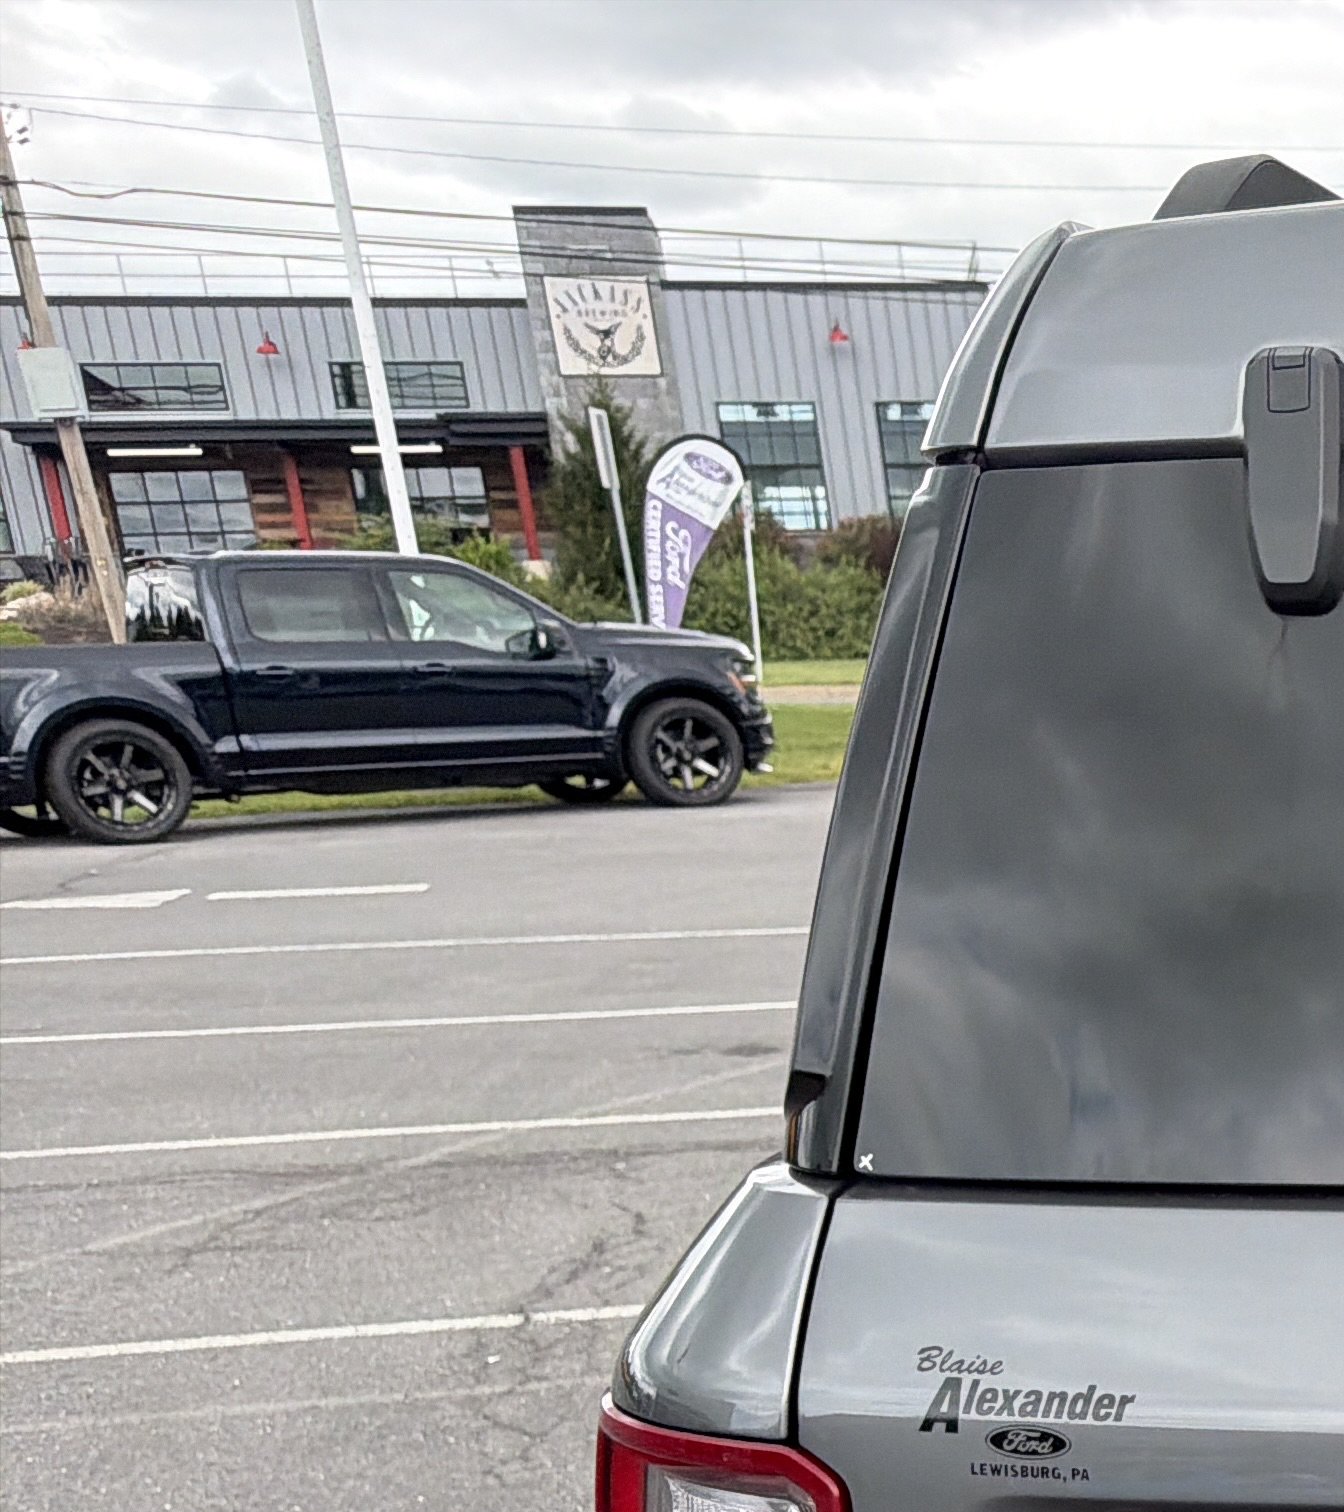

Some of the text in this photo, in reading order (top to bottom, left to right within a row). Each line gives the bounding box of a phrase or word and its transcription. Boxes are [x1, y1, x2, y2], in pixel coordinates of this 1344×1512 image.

[665, 521, 692, 590] Ford
[916, 1345, 1004, 1376] Blaise
[918, 1376, 1137, 1434] Alexander
[1002, 1430, 1054, 1454] Ford
[970, 1462, 1090, 1483] LEWISBURG, PA
